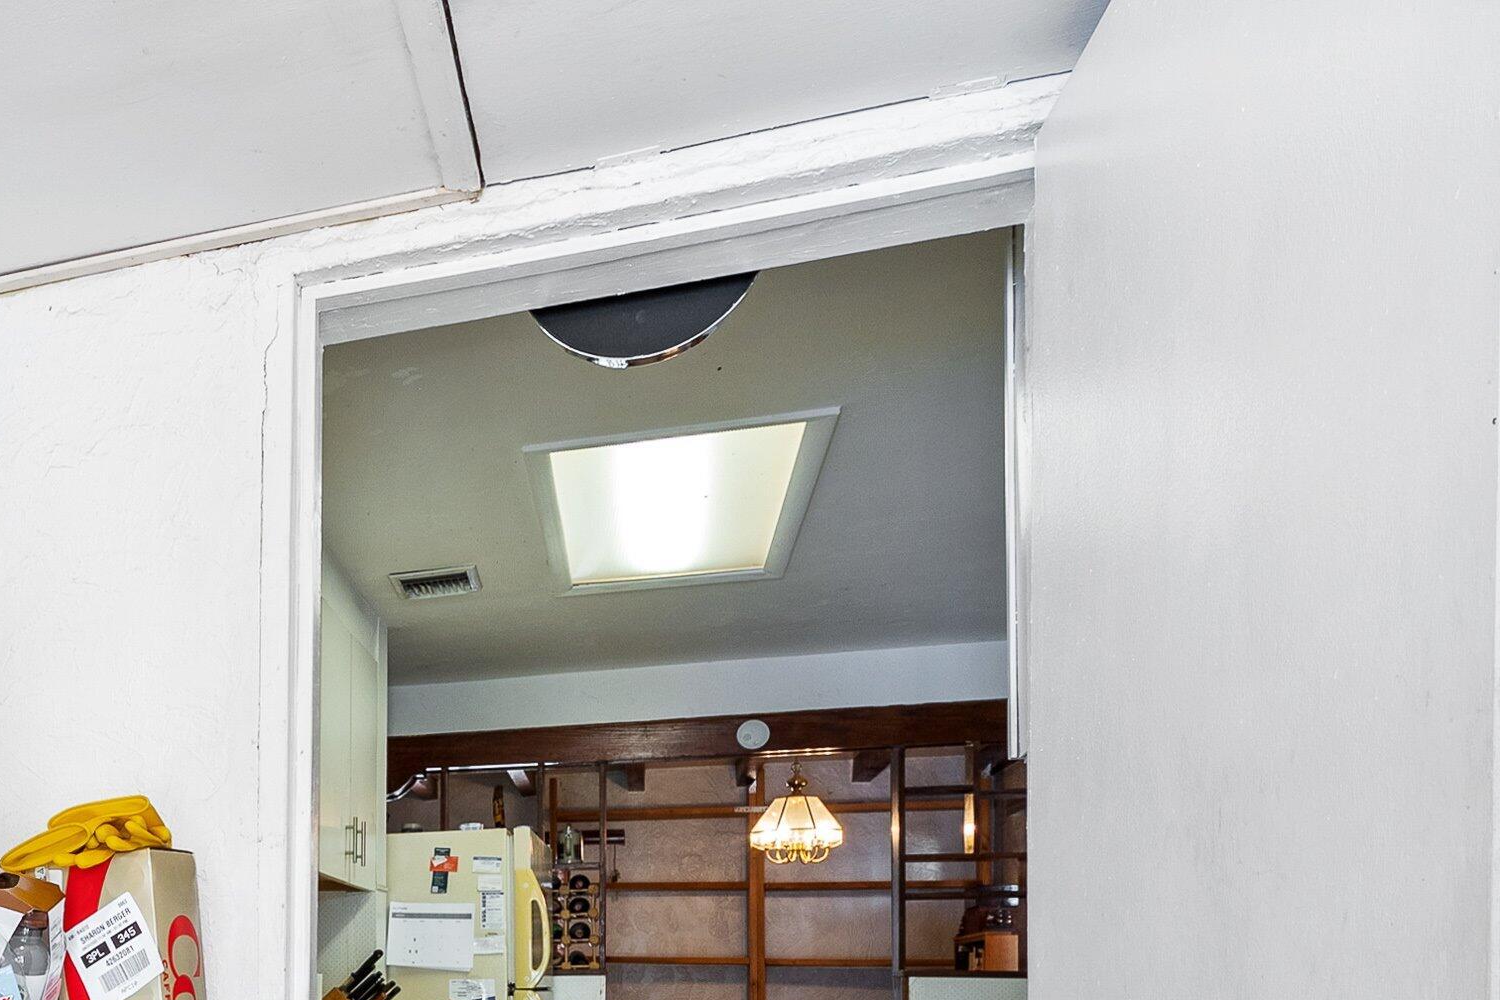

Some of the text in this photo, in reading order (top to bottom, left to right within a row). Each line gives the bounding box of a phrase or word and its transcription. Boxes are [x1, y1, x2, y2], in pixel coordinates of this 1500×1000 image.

[80, 925, 105, 945] SHARON
[105, 907, 131, 928] BERGER
[85, 949, 105, 964] 3PL
[117, 926, 136, 943] 345
